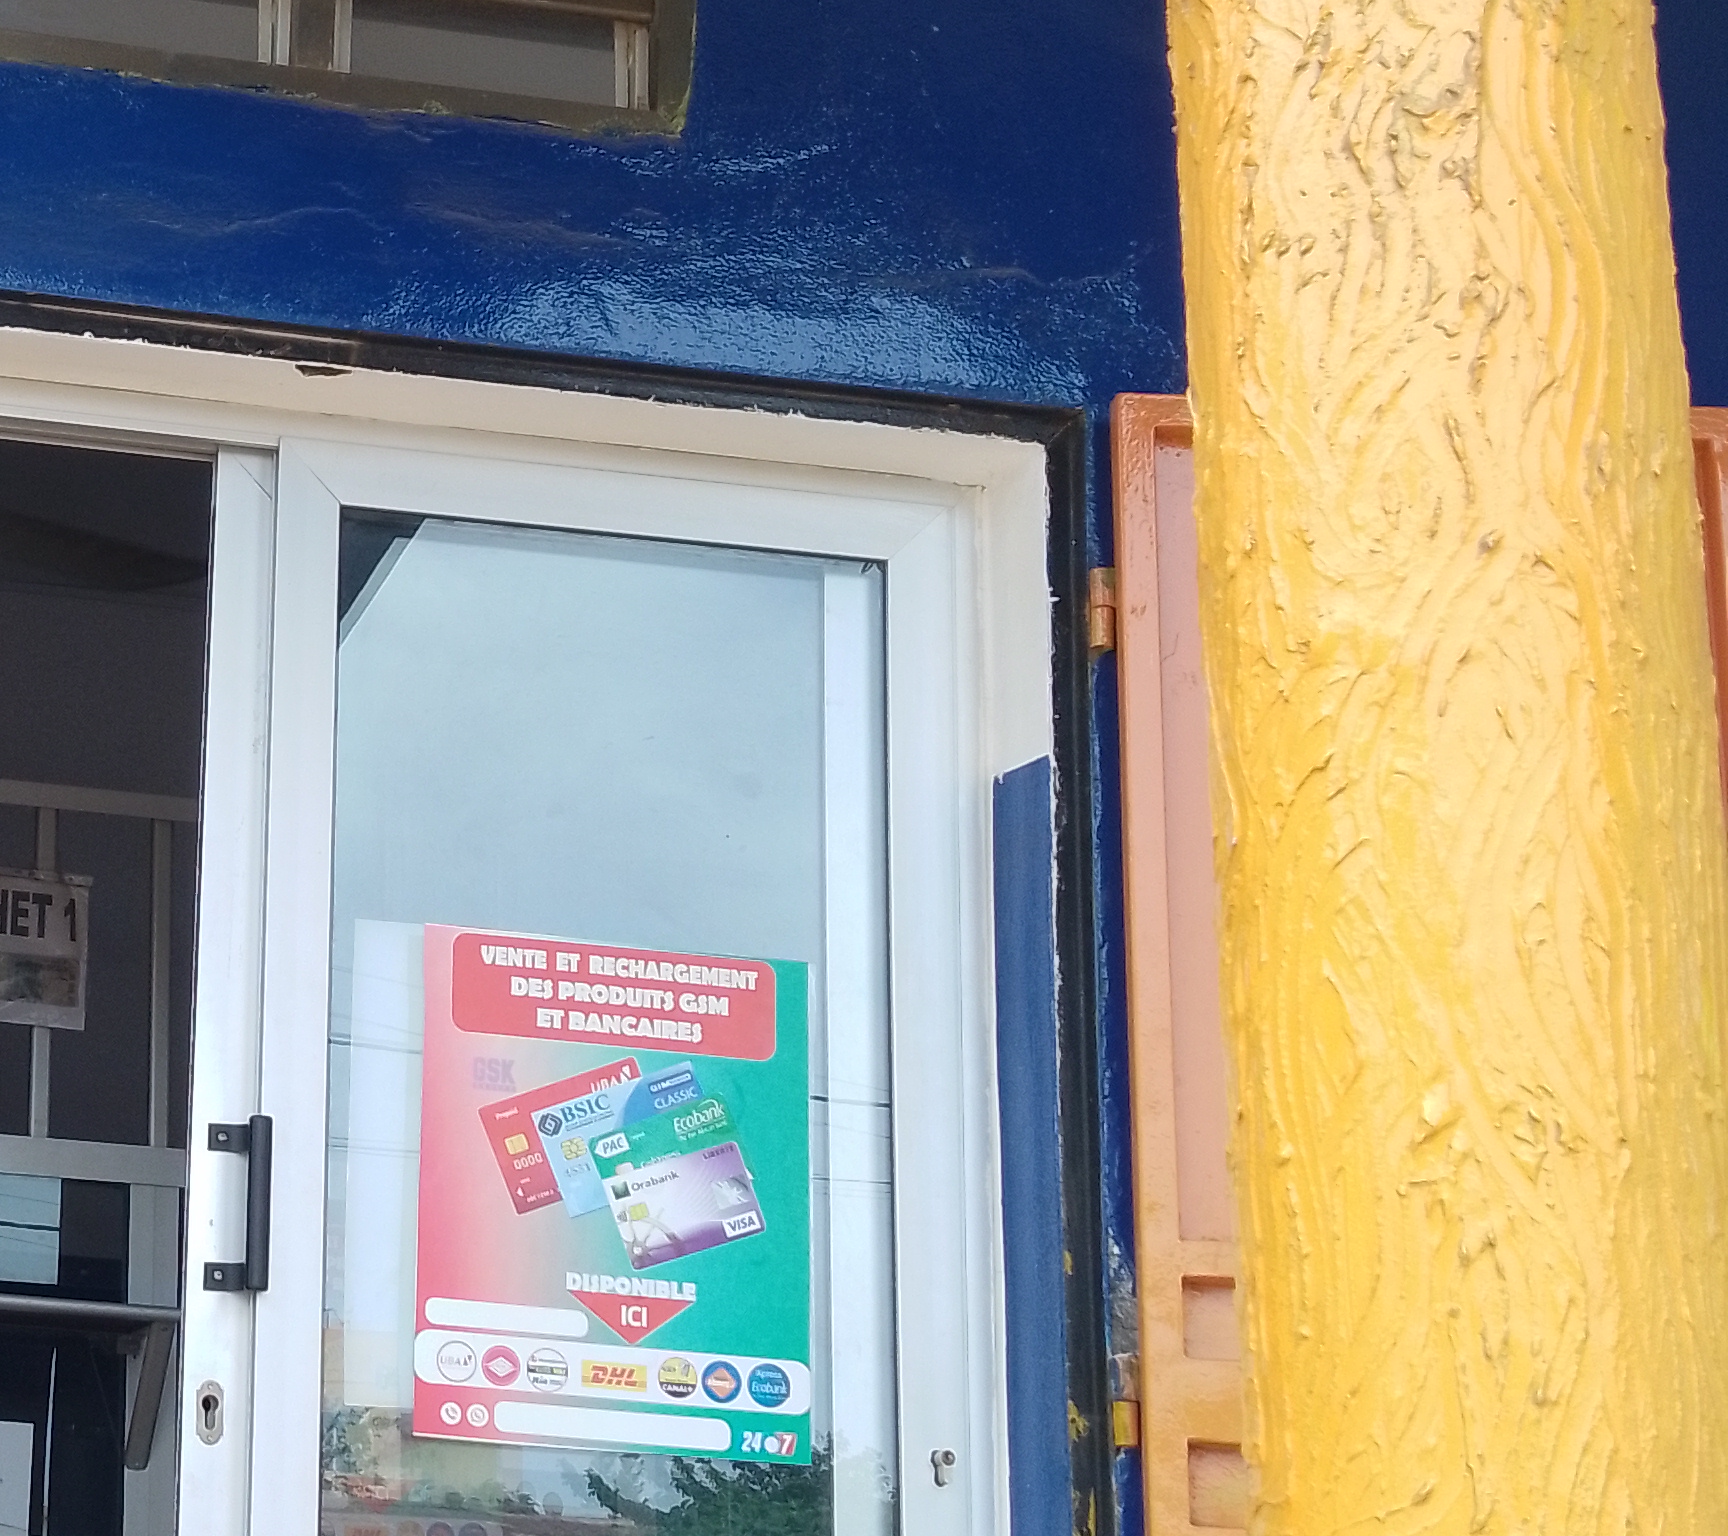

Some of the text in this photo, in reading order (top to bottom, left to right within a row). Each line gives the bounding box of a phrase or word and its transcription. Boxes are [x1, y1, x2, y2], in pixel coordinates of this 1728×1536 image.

[63, 898, 78, 942] 1
[480, 944, 759, 991] VENTE ET RECHARGEMENT
[510, 975, 730, 1017] DES PRODUITS GSM
[536, 1007, 703, 1043] ET BANCAIRES
[559, 1093, 611, 1124] BSIC
[653, 1085, 699, 1110] CLASSIC
[673, 1099, 726, 1133] Ecobank
[601, 1136, 626, 1156] PAC
[630, 1169, 680, 1192] Orabank
[726, 1214, 758, 1233] VISA
[565, 1271, 697, 1301] DISPONIBLE
[620, 1304, 648, 1328] ICI
[590, 1363, 639, 1388] DHL
